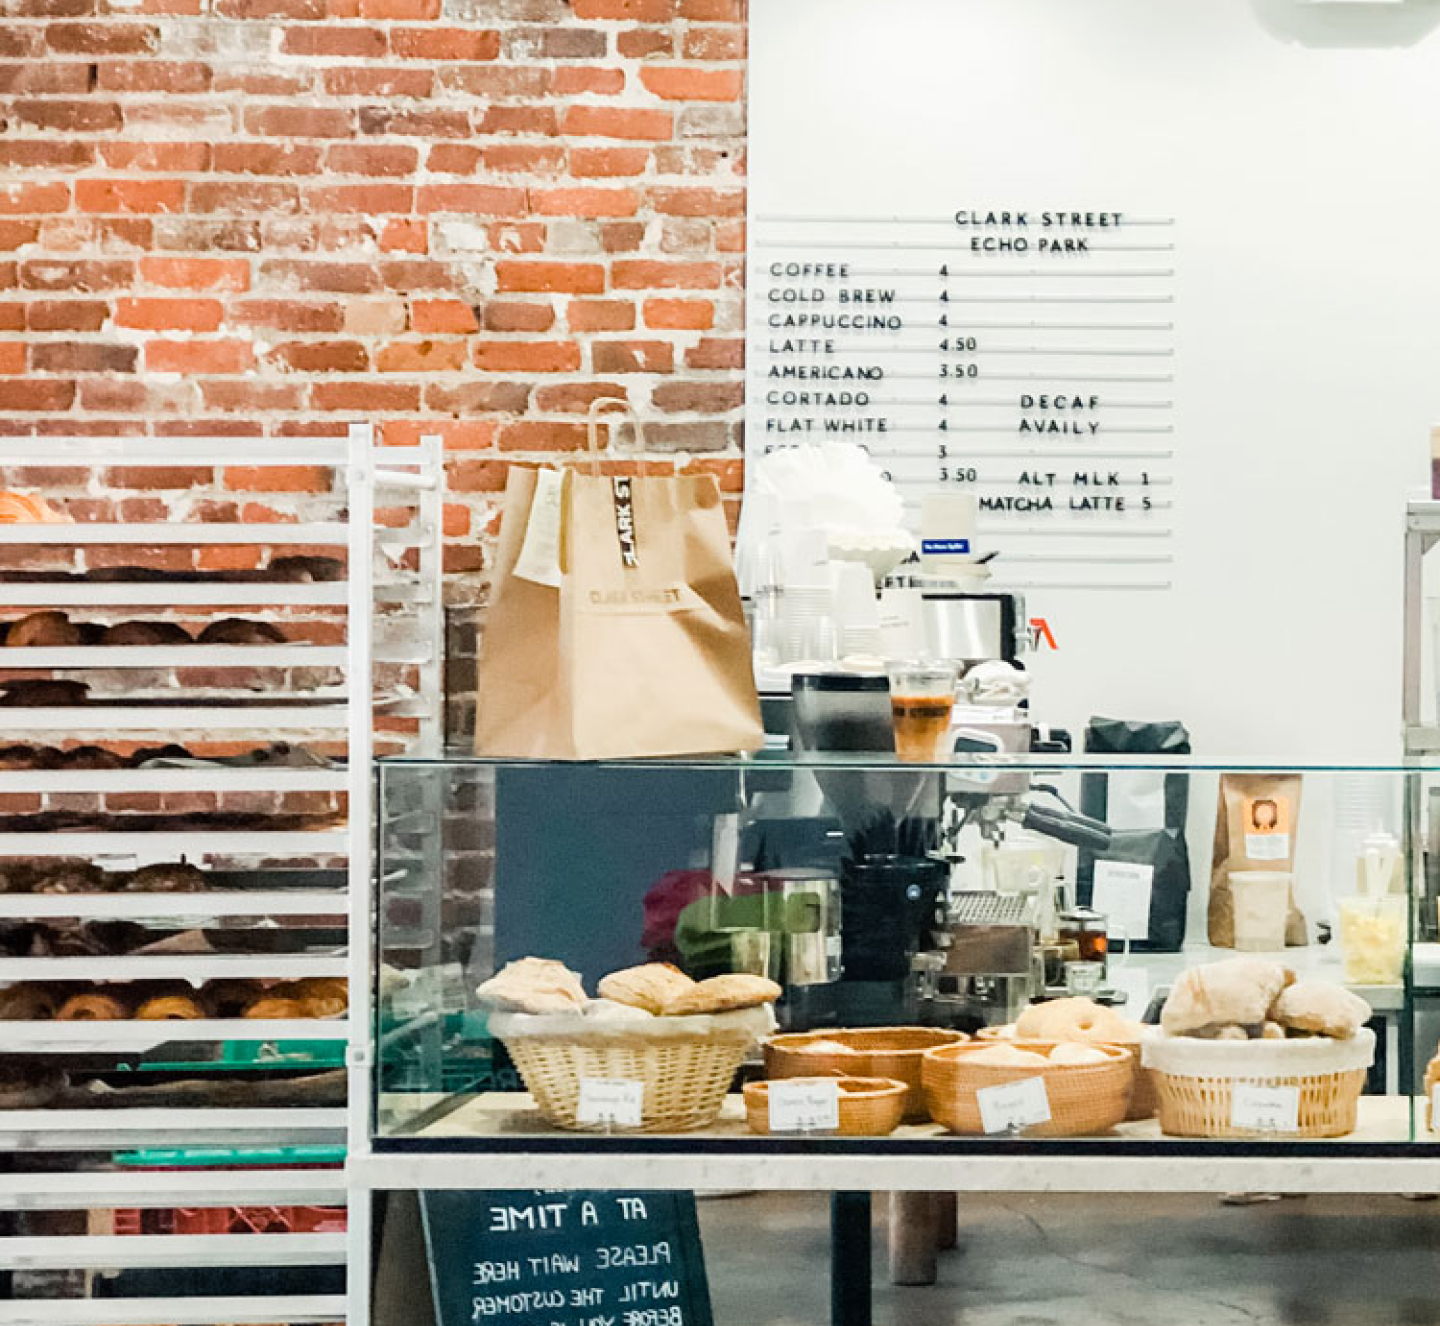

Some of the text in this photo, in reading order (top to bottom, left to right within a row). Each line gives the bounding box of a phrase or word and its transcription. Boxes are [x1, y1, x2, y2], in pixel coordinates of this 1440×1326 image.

[954, 209, 1122, 228] CLARK STREET
[969, 236, 1089, 253] ECHO PARK
[769, 263, 849, 278] COFFEE
[938, 264, 950, 278] 4
[766, 288, 896, 304] COLD BREW
[938, 290, 950, 303] 4
[768, 314, 902, 331] CAPPUCCINO
[938, 314, 949, 328] 4
[769, 339, 835, 354] LATTE
[938, 337, 978, 352] 4.50
[768, 365, 885, 381] AMERICANO
[938, 363, 979, 379] 3.50
[766, 391, 870, 406] CORTADO
[938, 393, 949, 407] 4
[1020, 394, 1100, 410] DECAF
[766, 418, 889, 434] FLAT WHITE
[938, 418, 949, 432] 4
[938, 444, 949, 459] 3
[938, 467, 978, 483] 3.50
[1018, 470, 1150, 487] ALT MLK 1
[978, 495, 1153, 512] MATCHA LATTE 5
